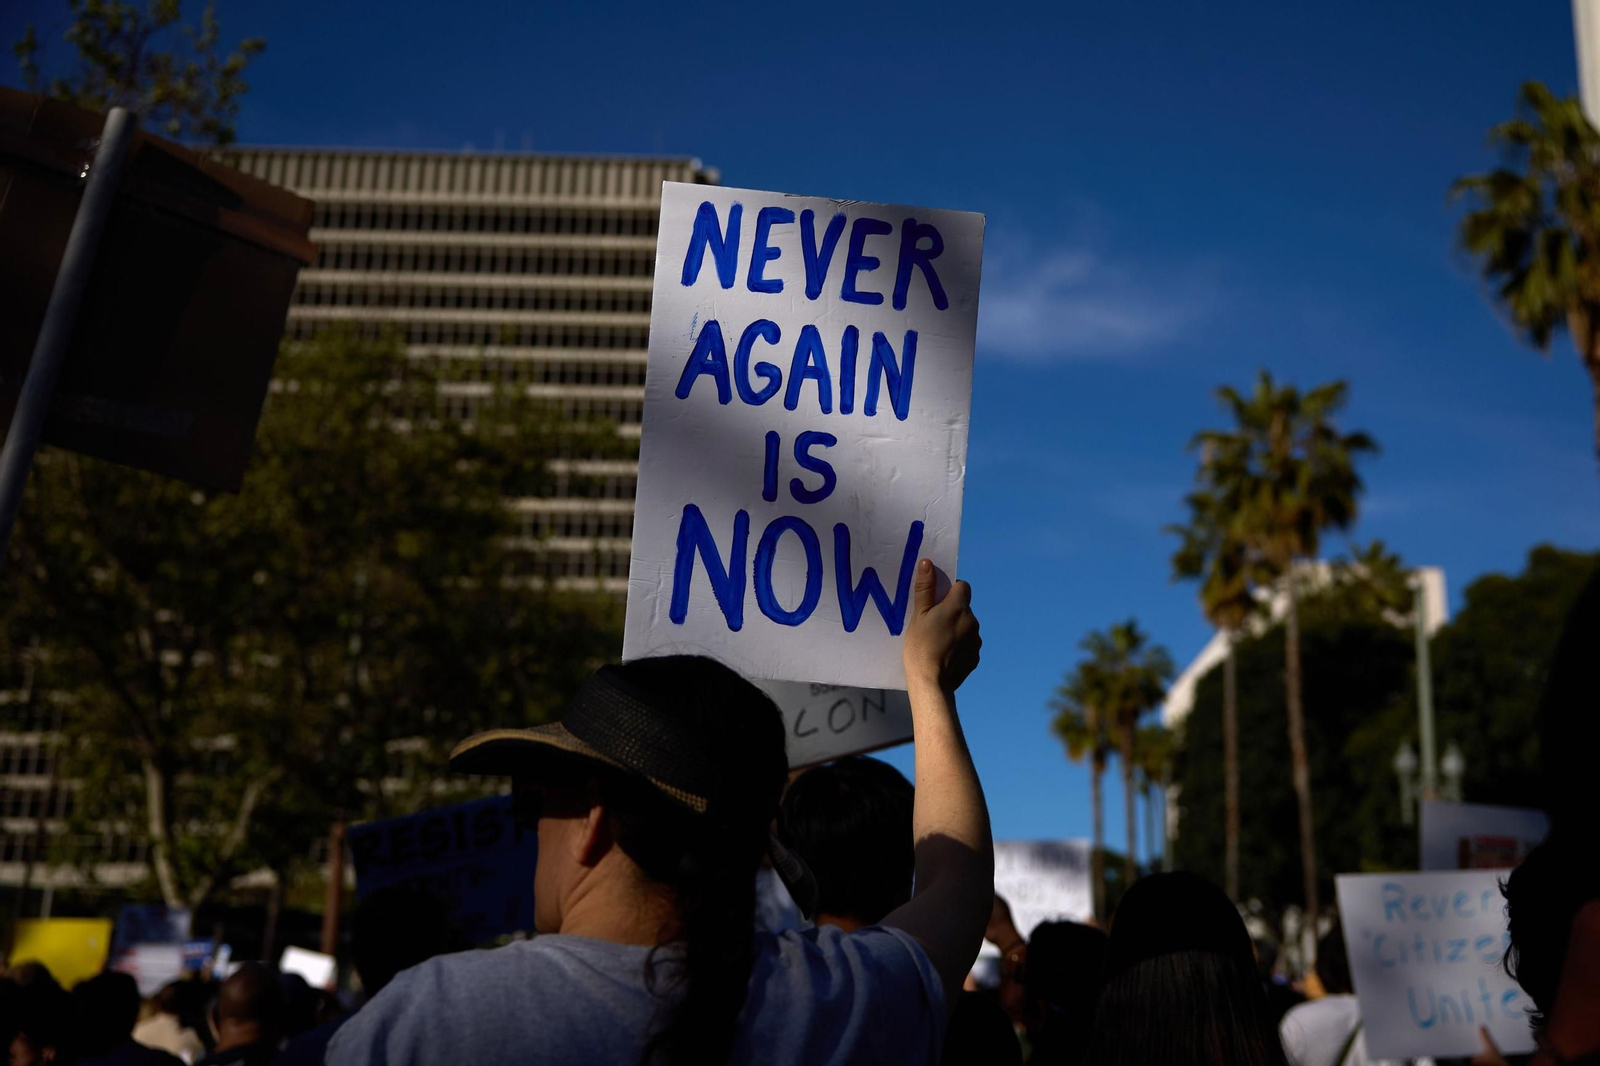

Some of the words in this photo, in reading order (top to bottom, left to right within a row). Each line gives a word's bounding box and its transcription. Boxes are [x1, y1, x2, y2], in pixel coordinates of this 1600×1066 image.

[681, 201, 949, 311] NEVER
[675, 319, 918, 420] AGAIN
[762, 431, 837, 503] IS
[669, 503, 925, 636] NOW
[1379, 881, 1500, 923] Rever
